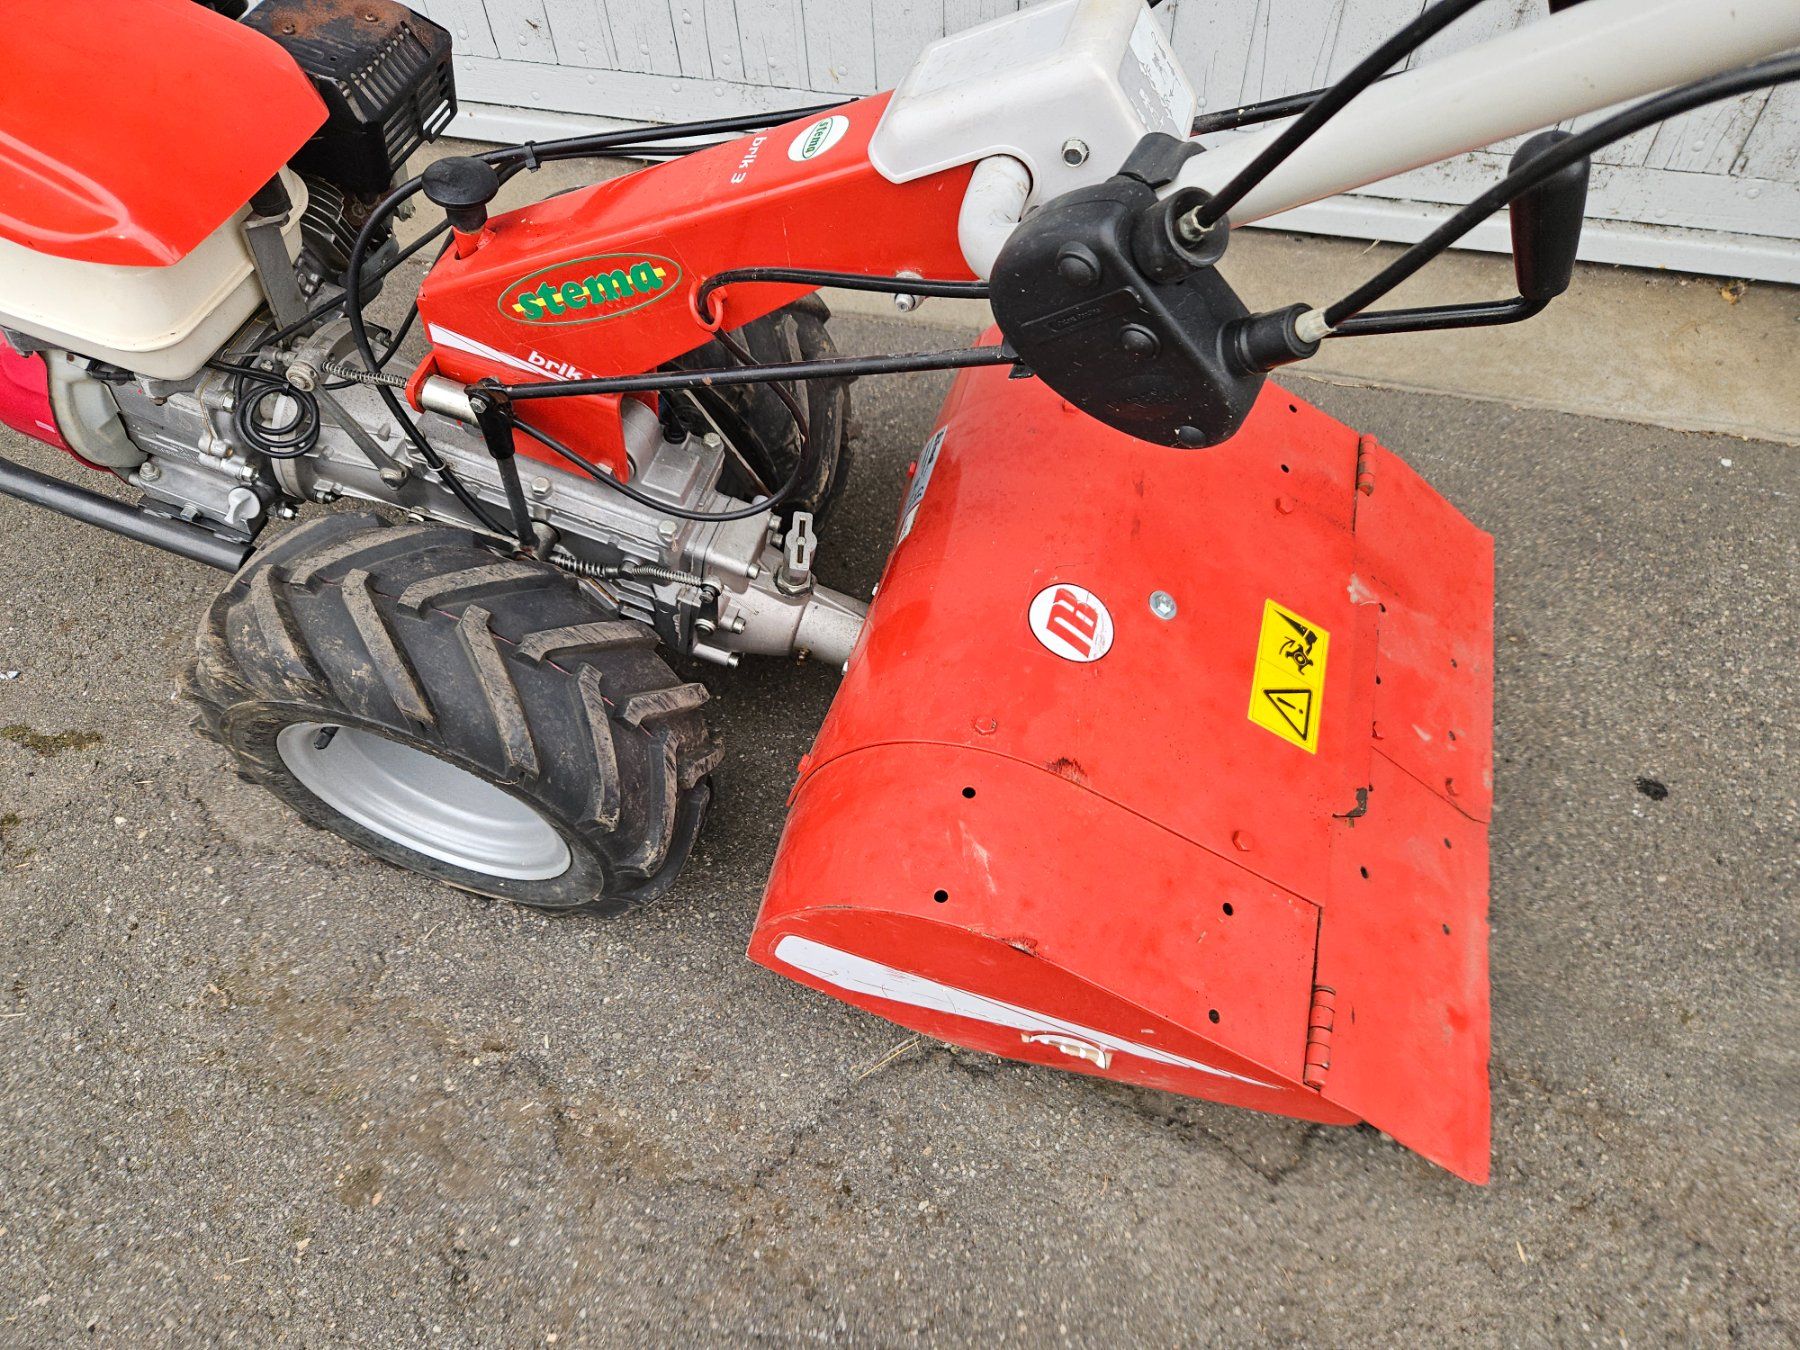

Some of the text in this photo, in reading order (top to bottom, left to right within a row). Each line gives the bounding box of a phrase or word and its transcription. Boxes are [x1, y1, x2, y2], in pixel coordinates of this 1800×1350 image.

[730, 136, 767, 184] brik 3
[805, 121, 829, 154] stema
[517, 260, 664, 320] stema
